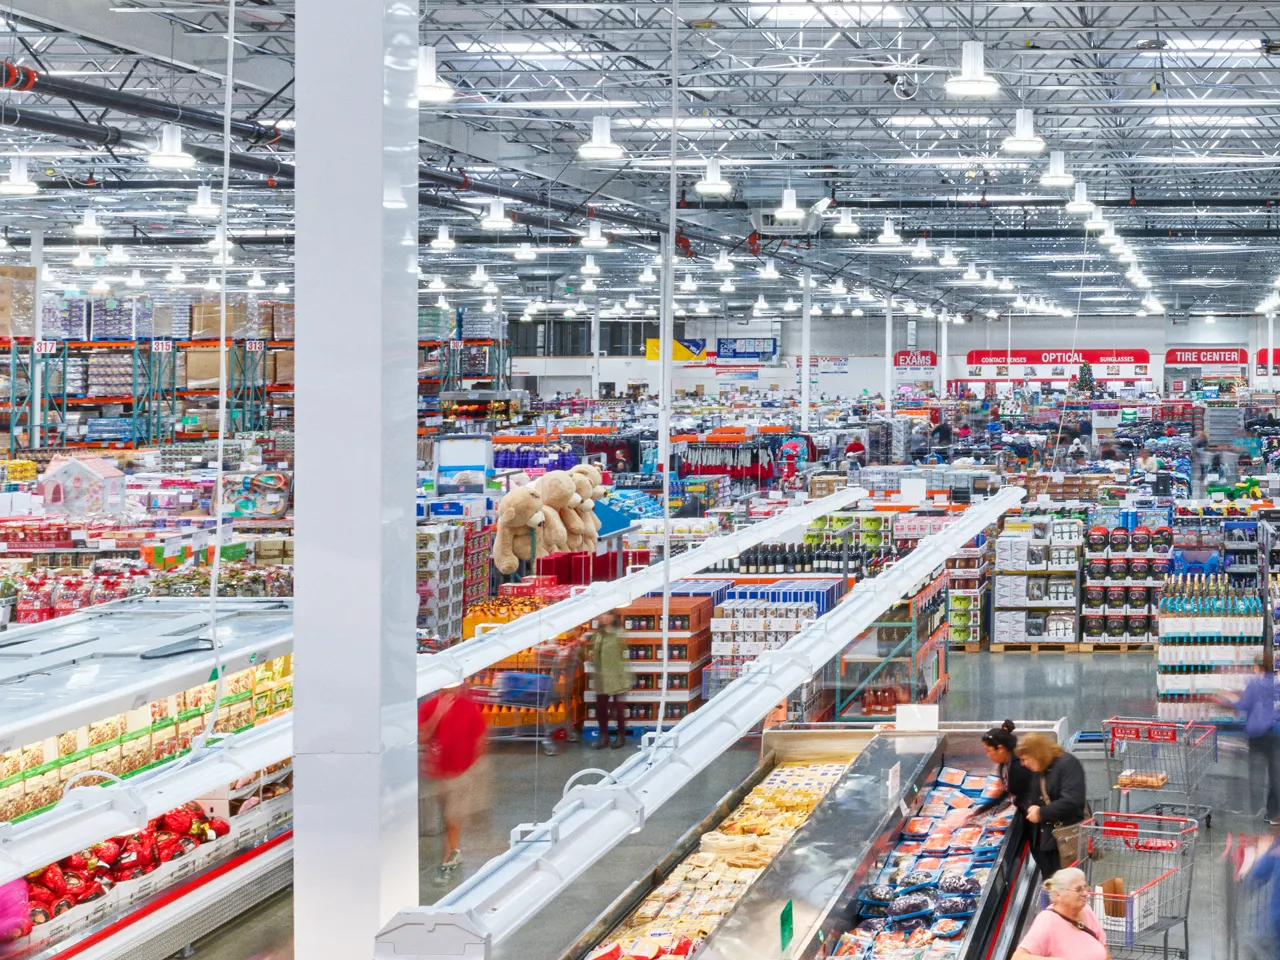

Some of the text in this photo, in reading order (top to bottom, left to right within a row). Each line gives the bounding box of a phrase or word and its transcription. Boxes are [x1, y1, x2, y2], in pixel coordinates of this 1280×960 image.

[36, 342, 55, 352] 317
[154, 342, 171, 351] 315
[248, 341, 263, 351] 313
[900, 355, 932, 365] EXAMS
[1041, 352, 1085, 363] OPTICAL
[1176, 351, 1238, 362] TIRE CENTER
